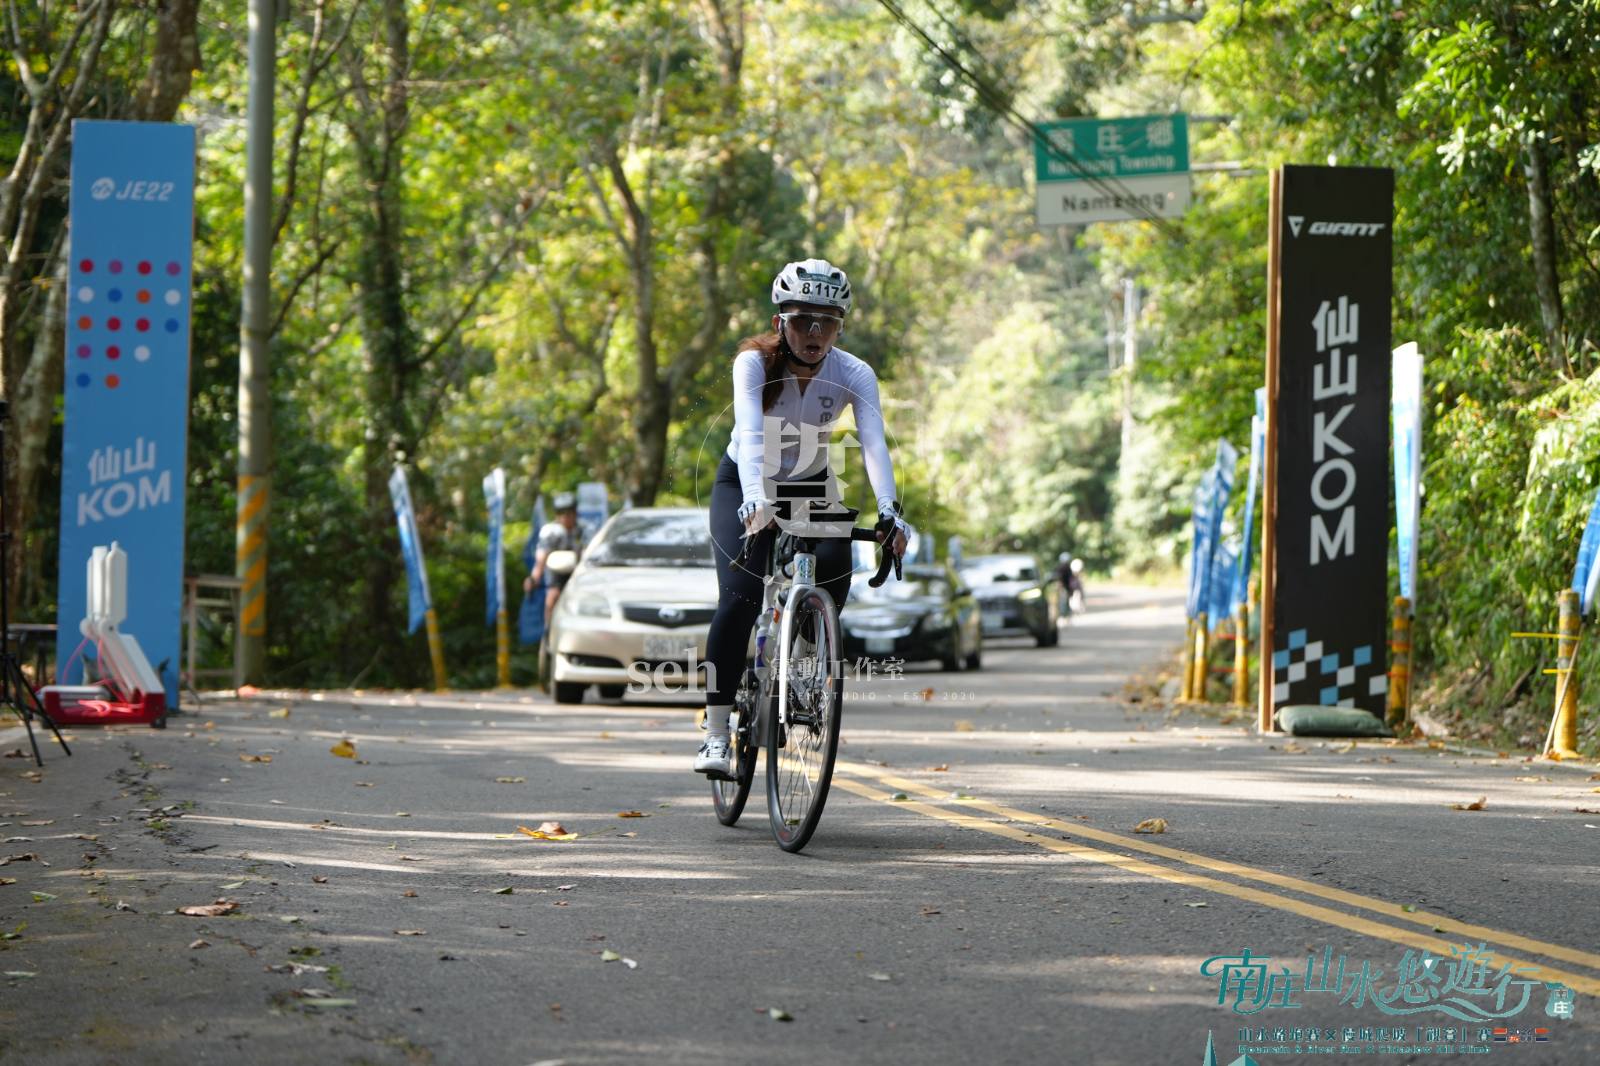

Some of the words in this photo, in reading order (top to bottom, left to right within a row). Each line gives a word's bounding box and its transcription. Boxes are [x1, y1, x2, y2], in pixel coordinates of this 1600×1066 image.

[116, 180, 175, 201] JE22
[1308, 221, 1386, 237] GIANT
[88, 437, 157, 486] 仙山
[77, 471, 172, 527] KOM
